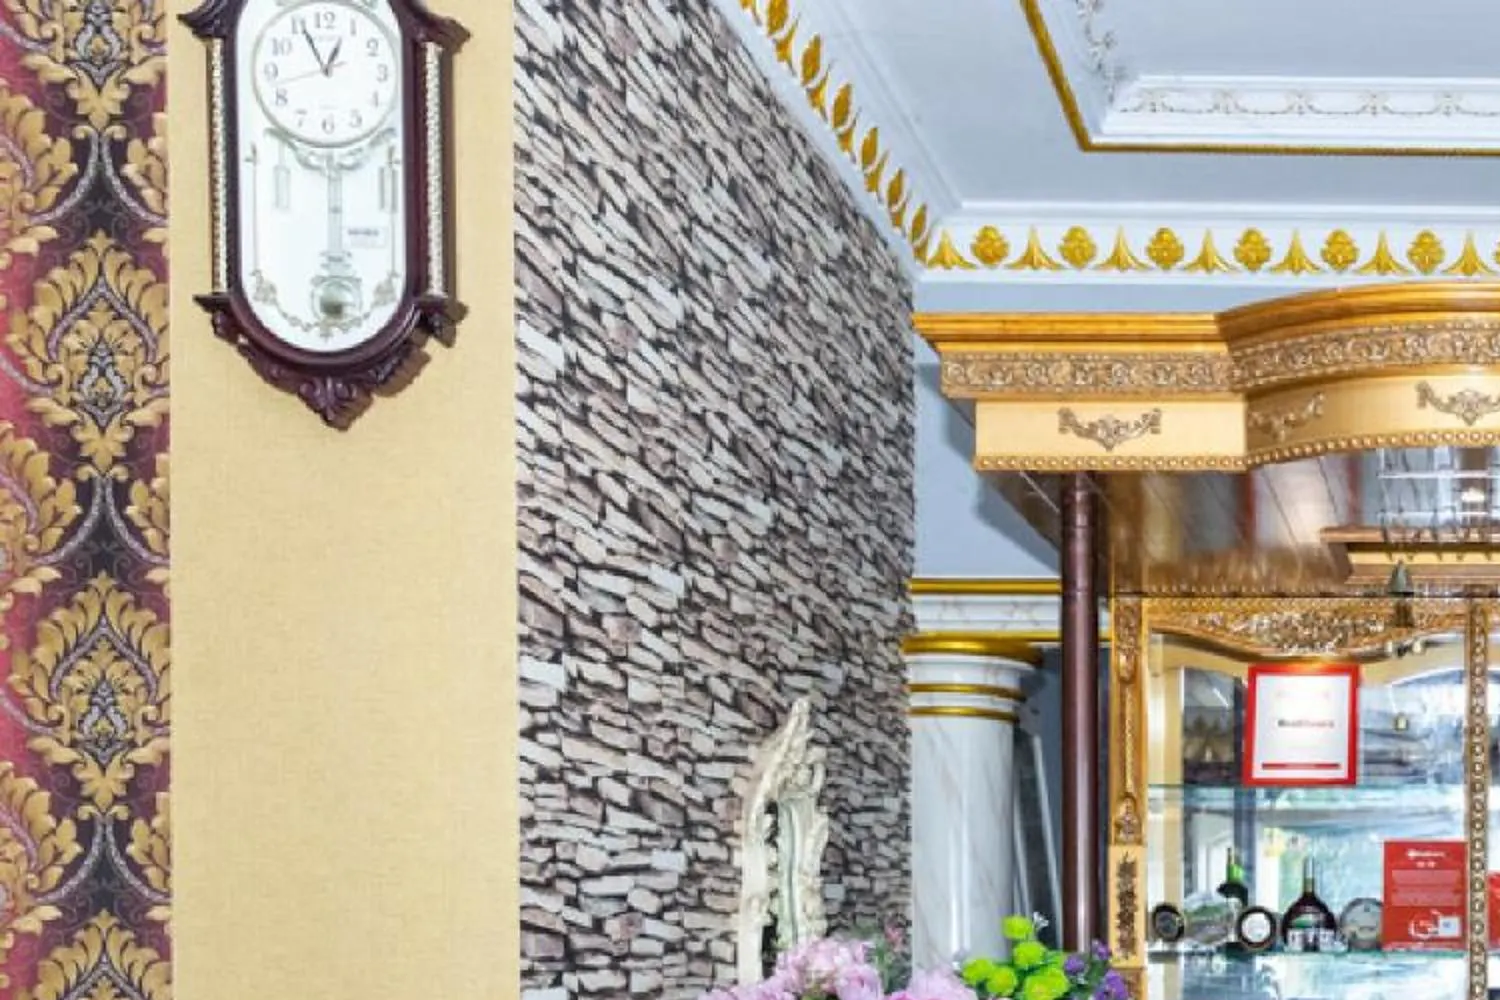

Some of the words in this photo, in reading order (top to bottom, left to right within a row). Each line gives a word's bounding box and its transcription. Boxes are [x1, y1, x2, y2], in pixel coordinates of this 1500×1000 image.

[314, 11, 336, 29] 12
[350, 18, 357, 36] 1
[272, 37, 292, 56] 10
[366, 37, 379, 57] 2
[263, 62, 279, 81] 9
[376, 63, 388, 82] 3
[275, 88, 288, 106] 8
[295, 108, 307, 128] 7
[321, 114, 335, 134] 6
[350, 109, 363, 128] 5
